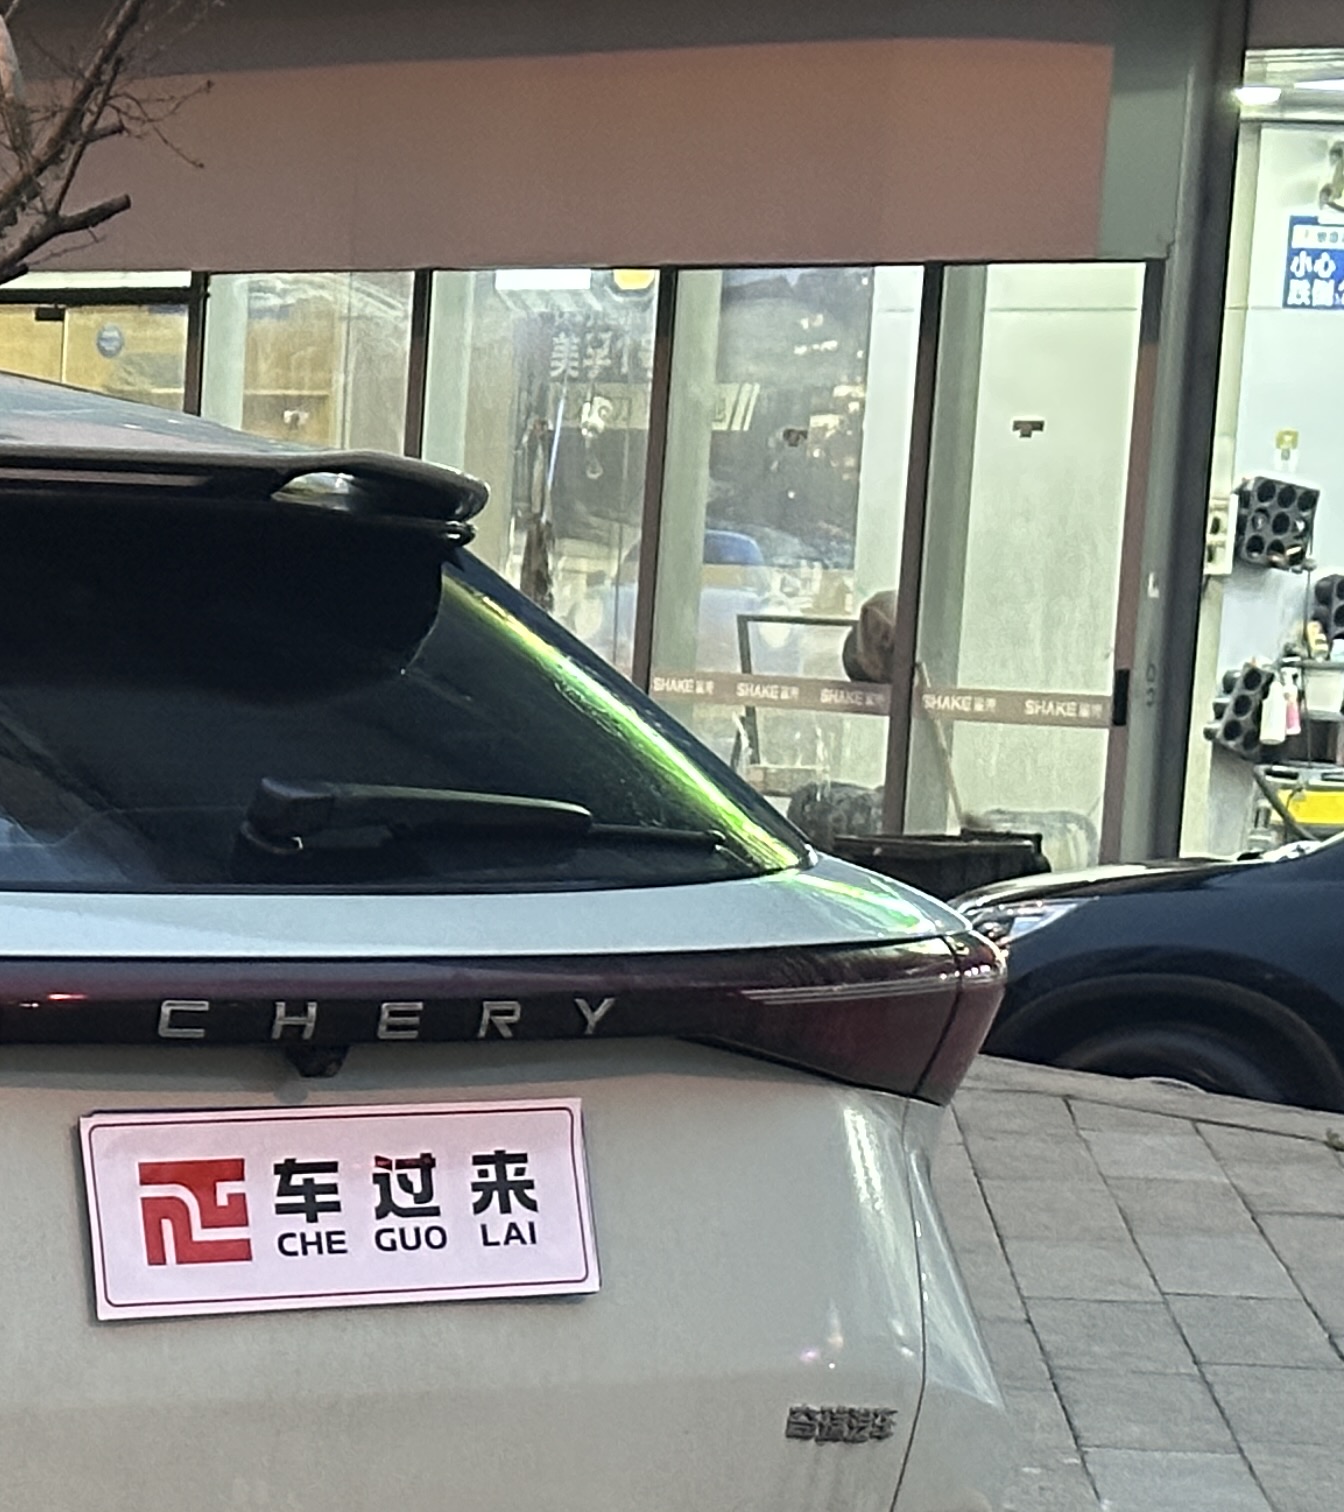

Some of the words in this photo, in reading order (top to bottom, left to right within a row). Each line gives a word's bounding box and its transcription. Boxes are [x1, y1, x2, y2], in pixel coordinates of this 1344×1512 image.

[653, 677, 694, 694] SHAKE
[737, 682, 779, 700] SHAKE
[820, 688, 863, 705] SHAKE
[923, 694, 971, 712] SHAKE
[1024, 699, 1077, 718] SHAKE
[157, 998, 615, 1040] CHERY
[273, 1149, 540, 1223] 车过来
[277, 1230, 348, 1257] CHE
[374, 1225, 448, 1252] GUO
[481, 1221, 538, 1248] LAI
